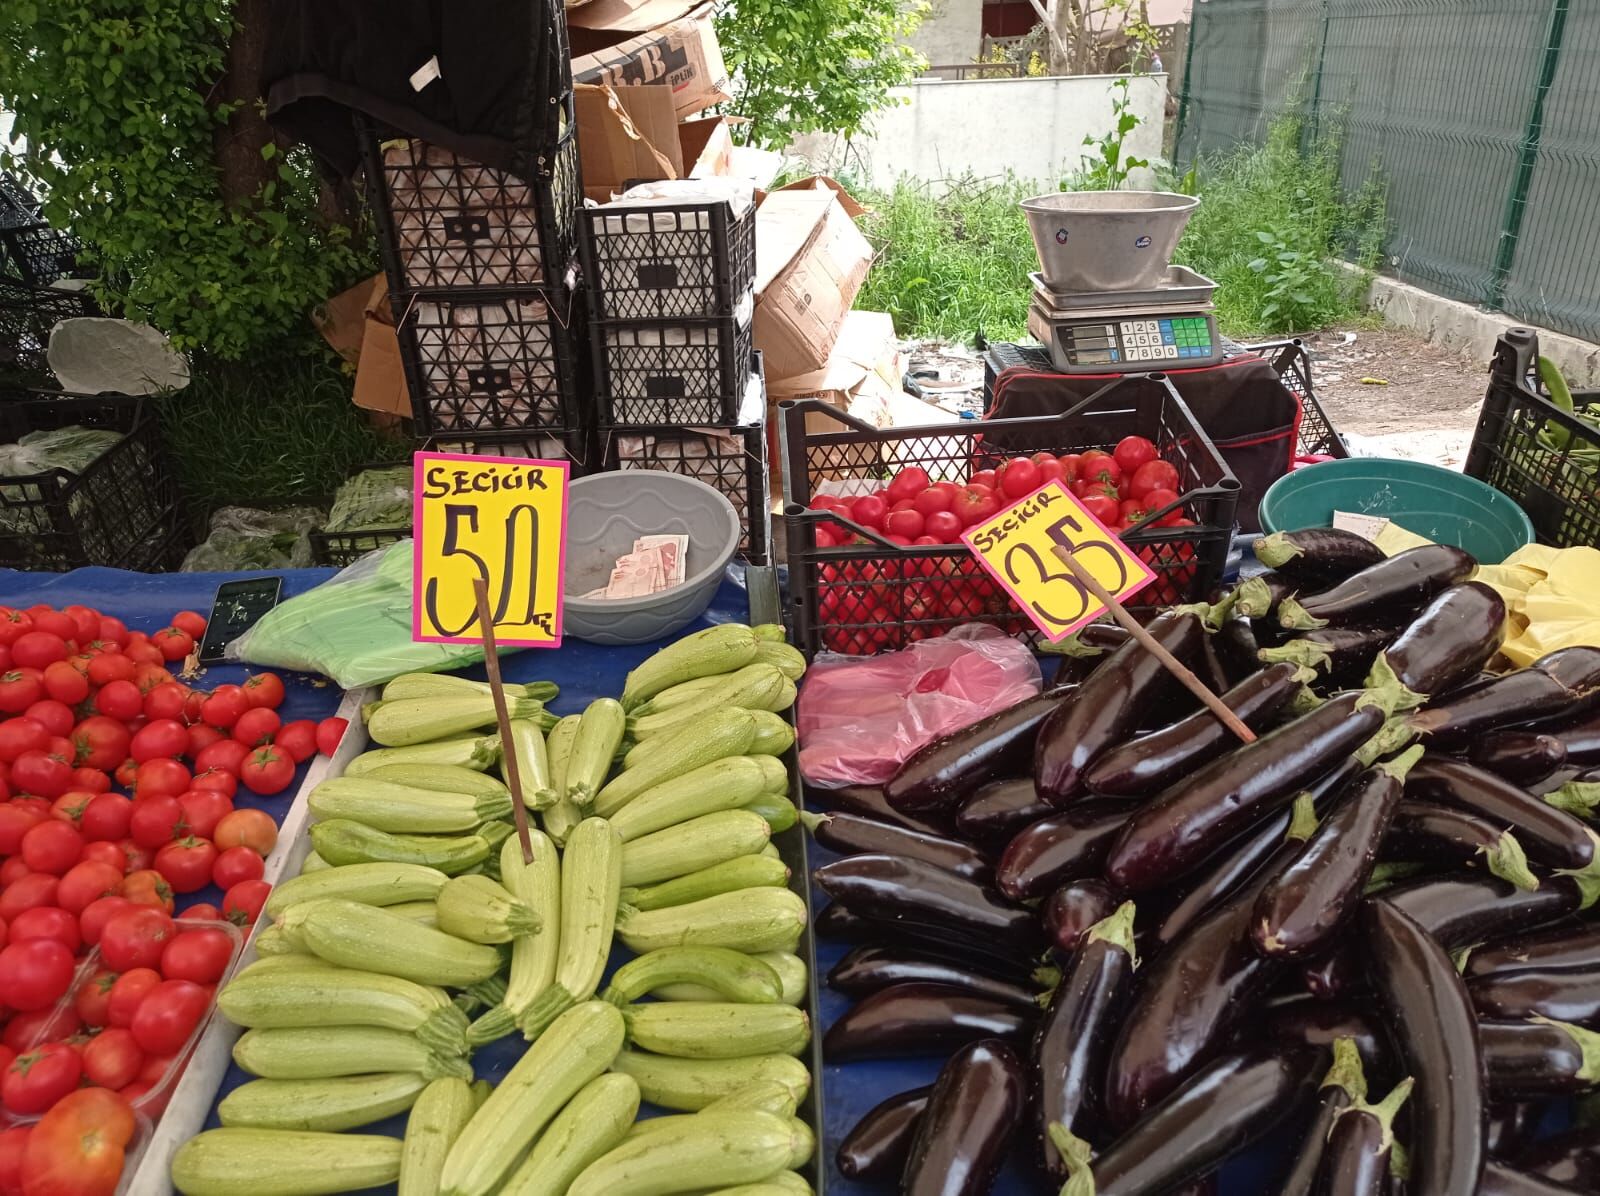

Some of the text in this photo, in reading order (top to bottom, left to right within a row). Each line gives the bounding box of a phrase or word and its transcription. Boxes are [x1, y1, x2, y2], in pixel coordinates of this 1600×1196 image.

[1136, 323, 1144, 332] 2
[1149, 322, 1157, 331] 3
[1126, 336, 1133, 345] 4
[1139, 335, 1146, 345] 5
[1152, 335, 1159, 344] 6
[1128, 347, 1175, 359] 7 8 9 0
[425, 503, 538, 637] 50
[1004, 514, 1128, 626] 35
